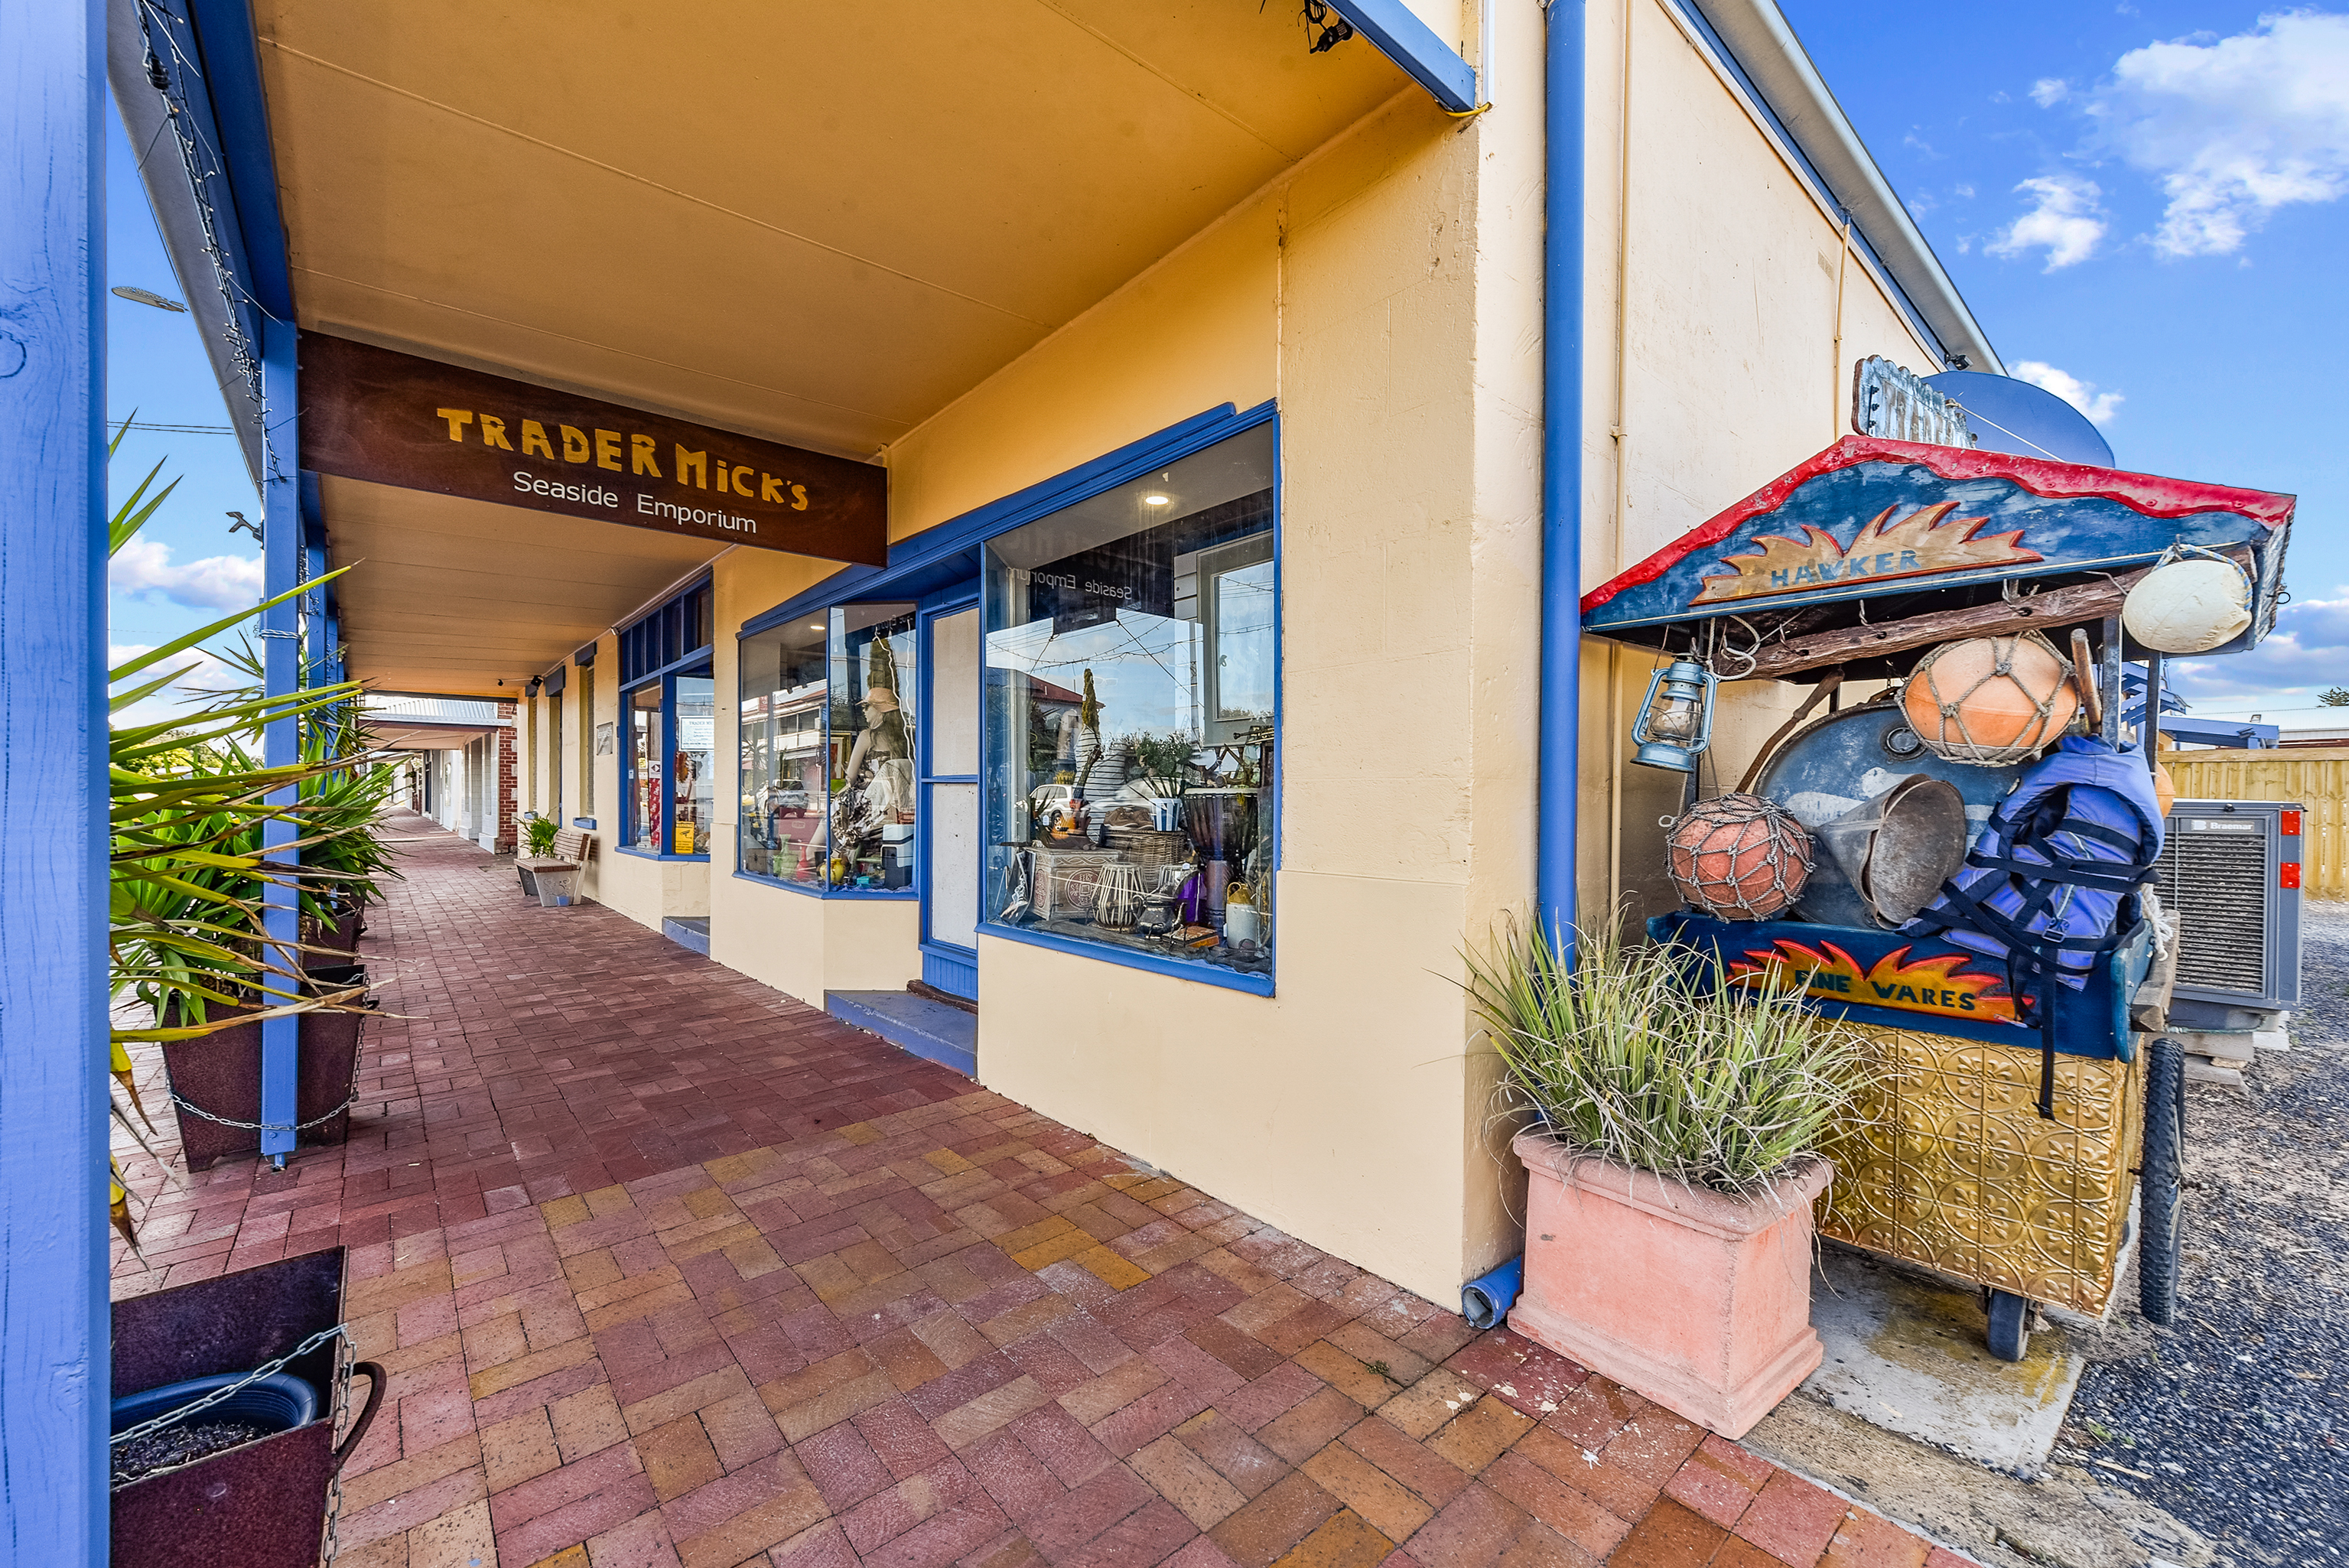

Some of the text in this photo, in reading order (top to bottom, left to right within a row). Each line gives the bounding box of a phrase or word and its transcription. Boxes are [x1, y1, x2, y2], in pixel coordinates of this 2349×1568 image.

[437, 408, 662, 479] TRADER
[513, 470, 757, 534] Seaside Emporium
[1771, 550, 1921, 588] HAWKER
[2210, 821, 2253, 830] Braemar
[1870, 981, 1976, 1011] WARES
